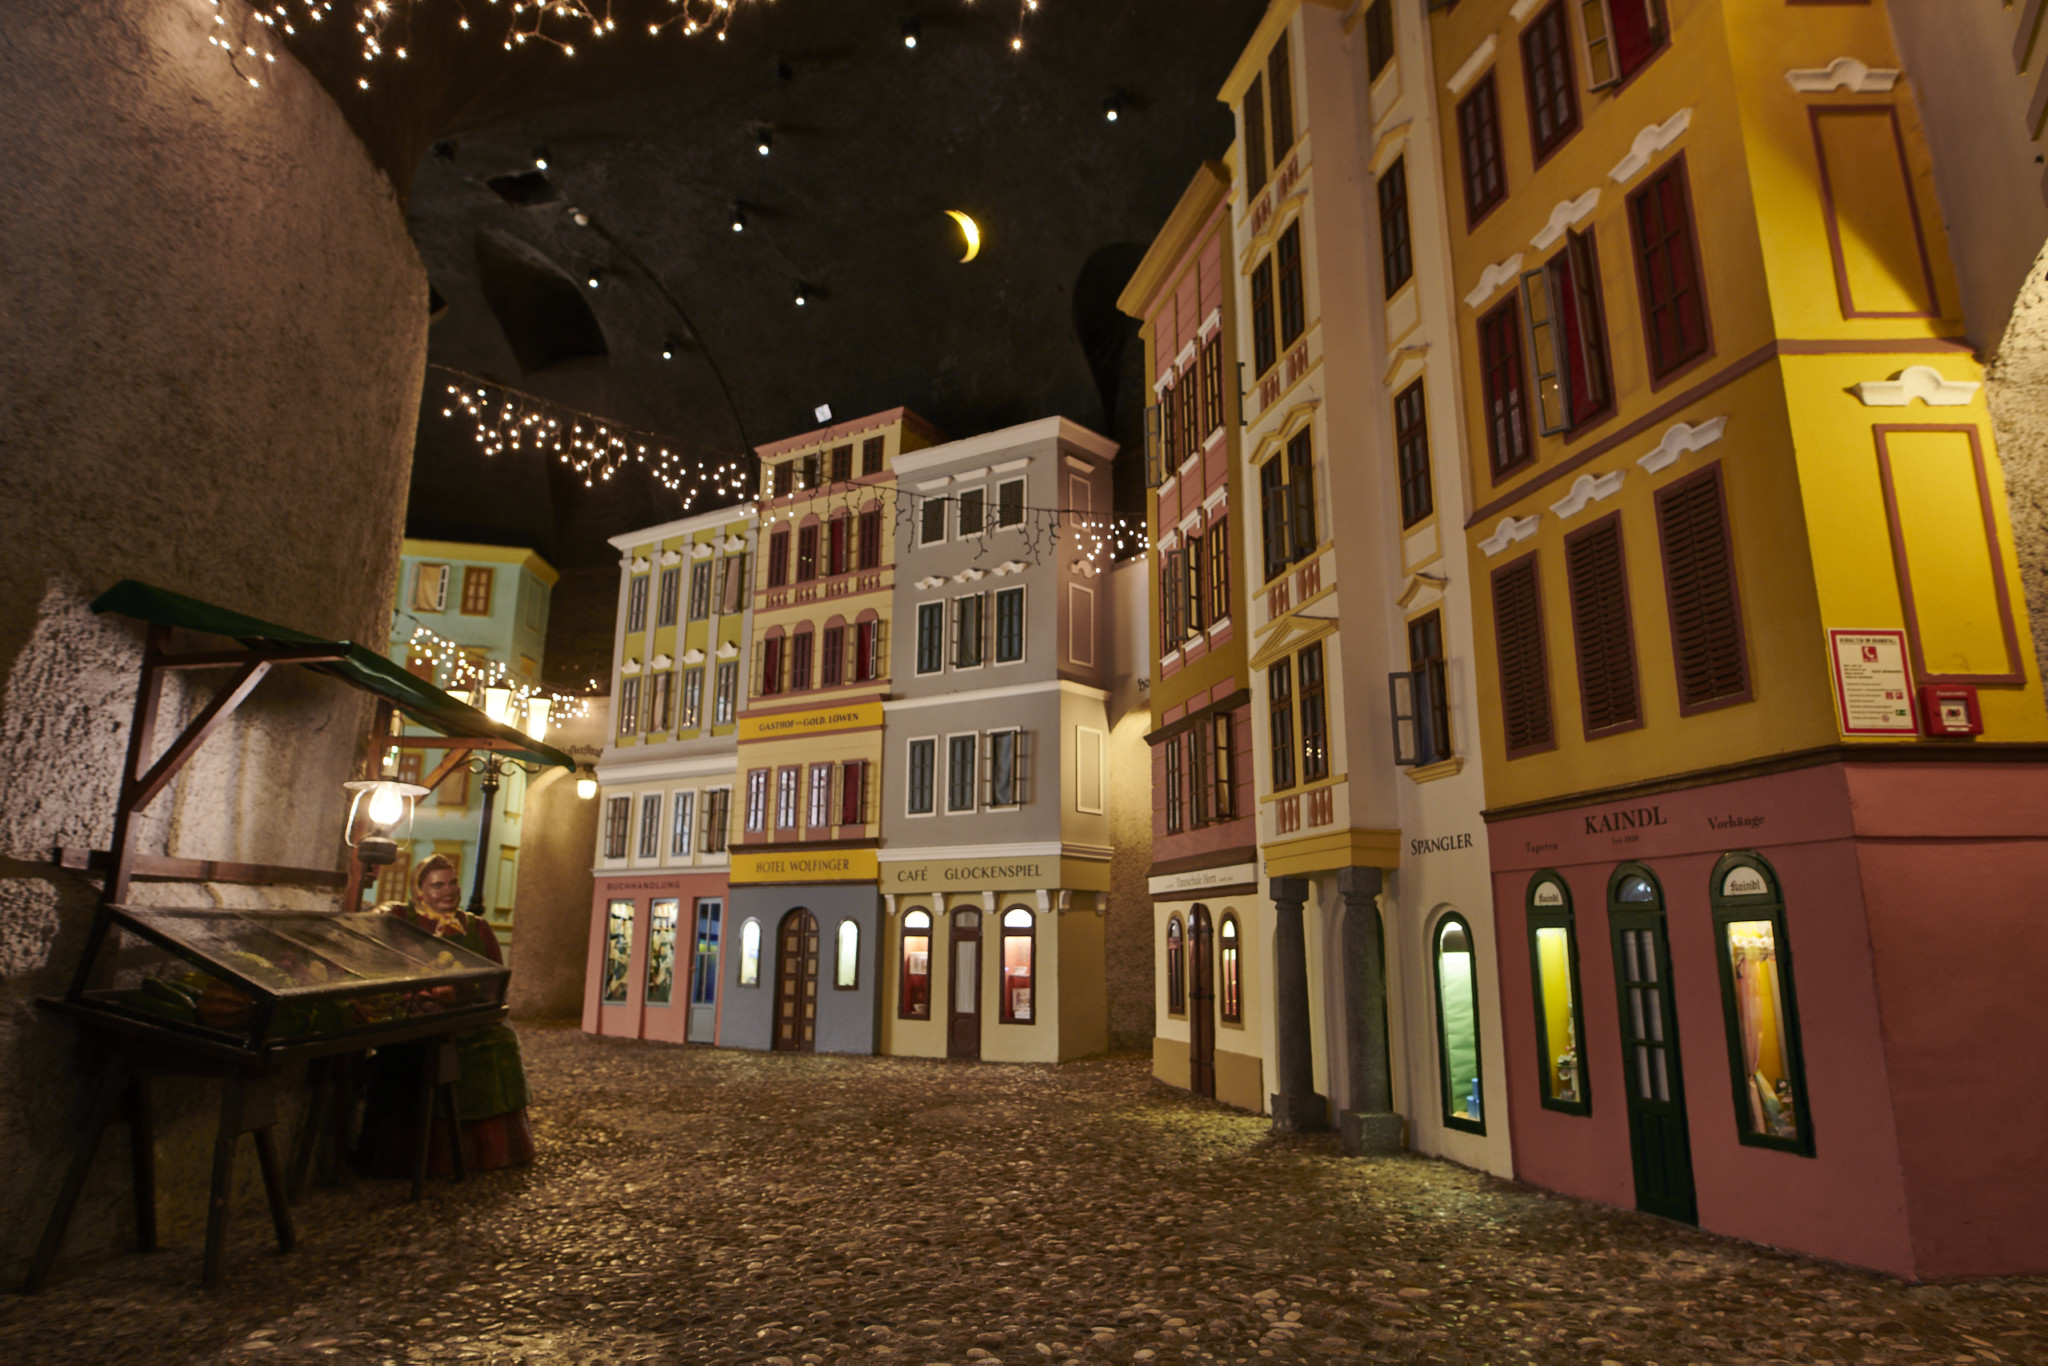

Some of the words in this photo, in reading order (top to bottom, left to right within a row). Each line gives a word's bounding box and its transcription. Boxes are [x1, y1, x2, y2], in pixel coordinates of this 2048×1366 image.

[758, 719, 794, 732] GASTHOF
[828, 712, 859, 724] LÖWEN
[1585, 806, 1667, 835] KAINDL
[1708, 814, 1765, 831] Vorhänge
[1411, 833, 1473, 855] SPÄNGLER
[1525, 842, 1558, 854] Tapeten
[756, 861, 785, 873] HOTEL
[789, 858, 850, 872] WOLFINGER
[897, 866, 928, 882] CAFÉ
[944, 864, 1042, 880] GLOCKENSPIEL
[606, 880, 680, 891] BUCHHANDLUNG
